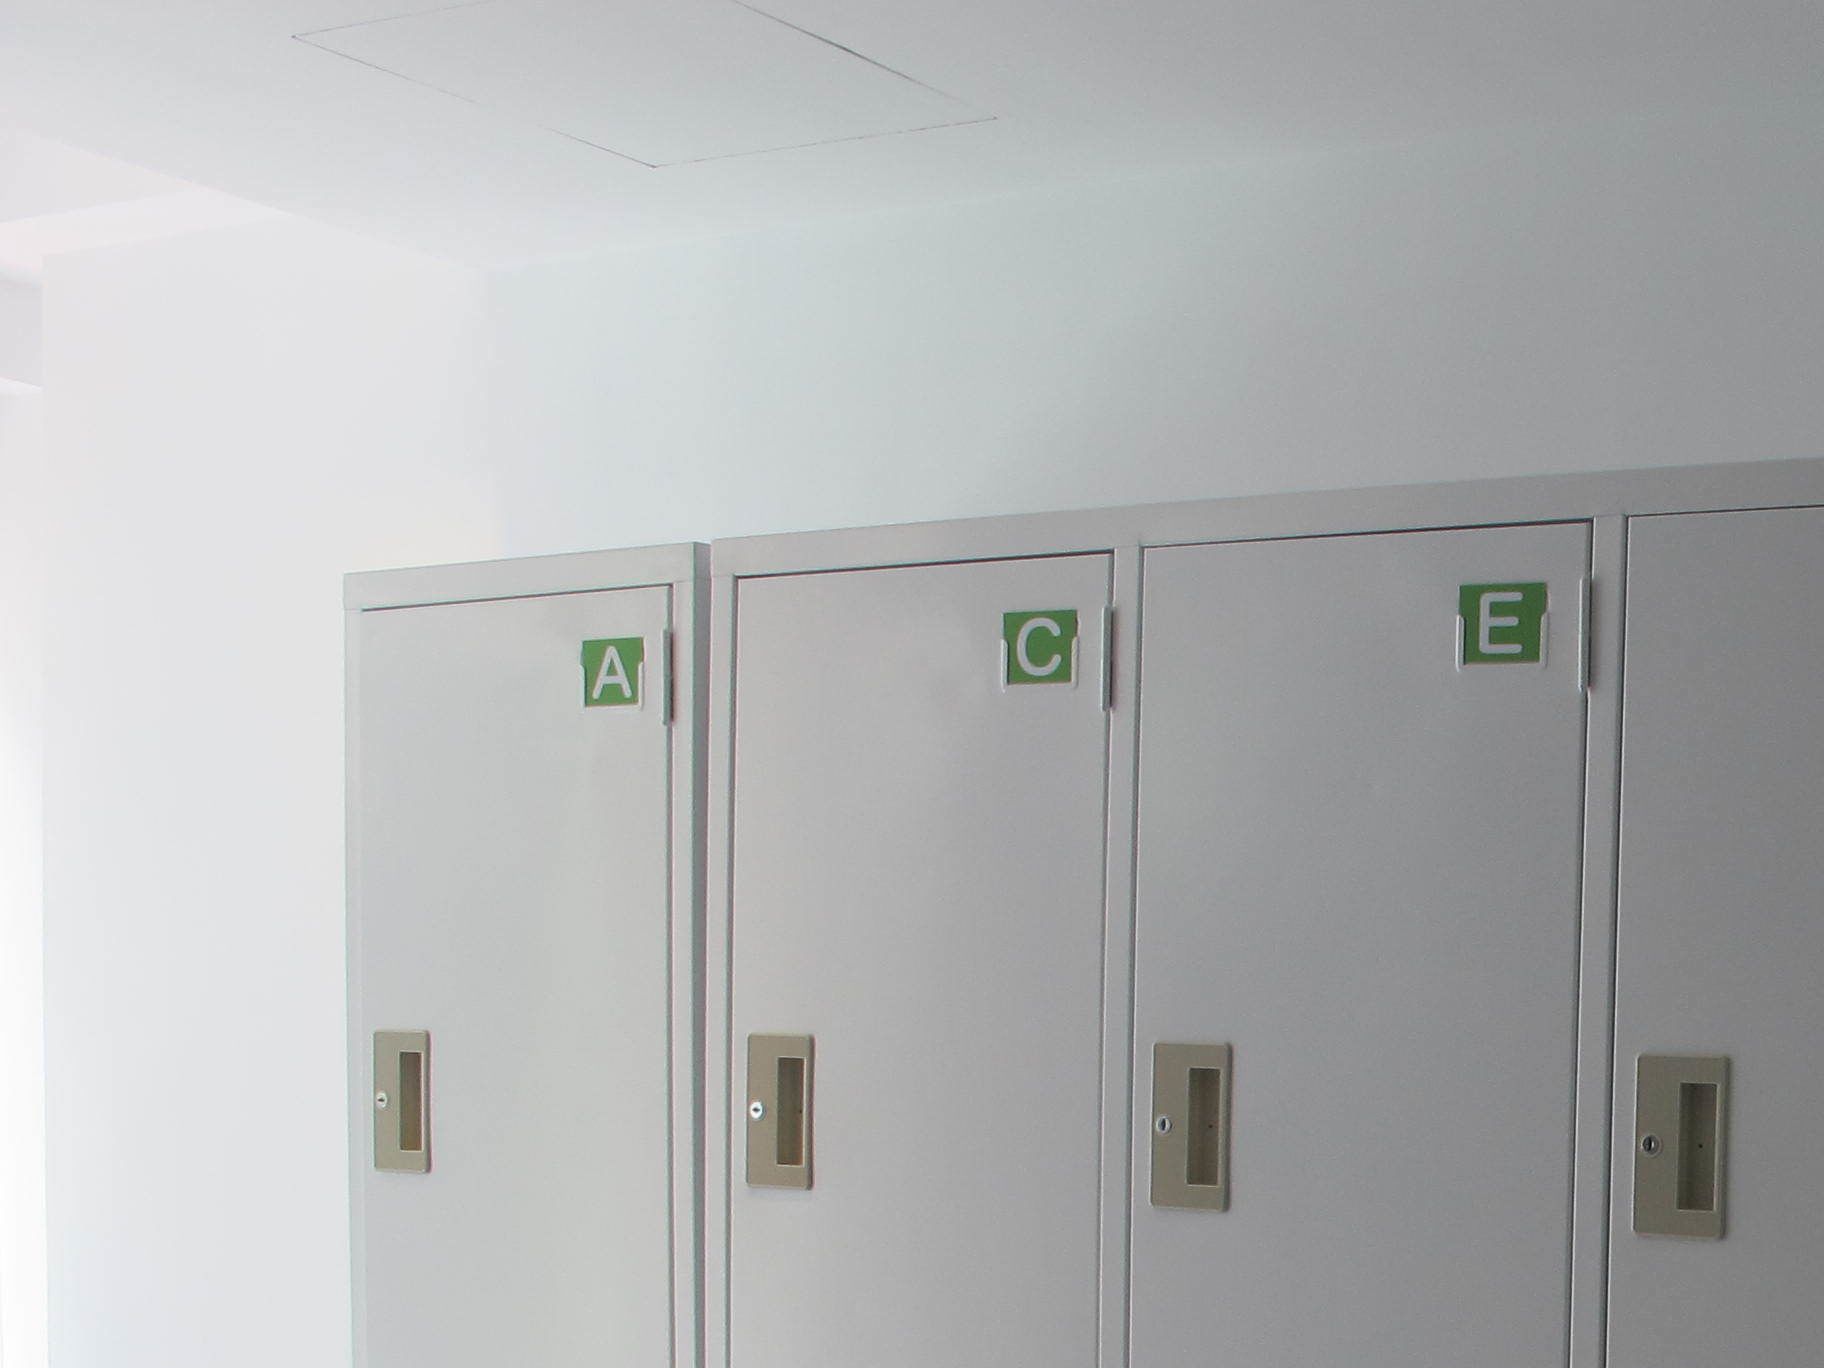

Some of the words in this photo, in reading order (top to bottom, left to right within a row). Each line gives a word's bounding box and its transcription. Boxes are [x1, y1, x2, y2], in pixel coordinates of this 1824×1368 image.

[1017, 617, 1062, 676] C
[1479, 592, 1523, 654] E
[592, 645, 632, 699] A
